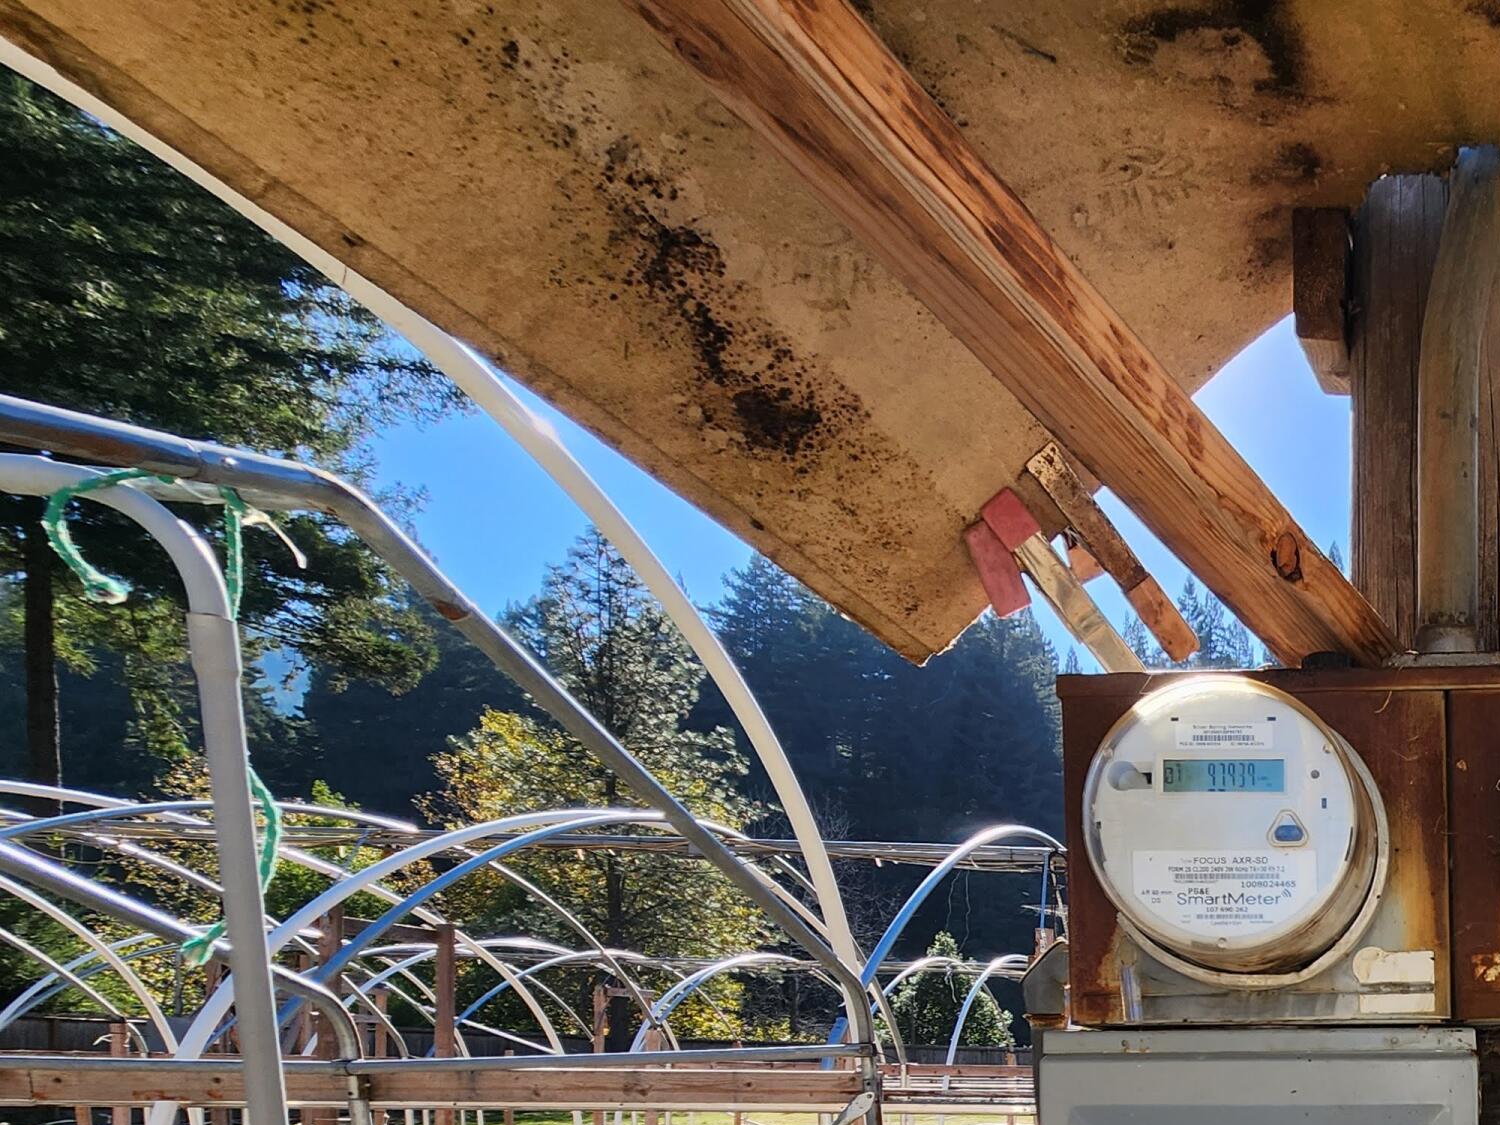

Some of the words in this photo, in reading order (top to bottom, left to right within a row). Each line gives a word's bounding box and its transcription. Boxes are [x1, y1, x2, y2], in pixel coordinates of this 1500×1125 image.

[1193, 856, 1227, 865] FOCUS
[1187, 887, 1210, 895] PG&E
[1176, 892, 1281, 905] SmartMeter
